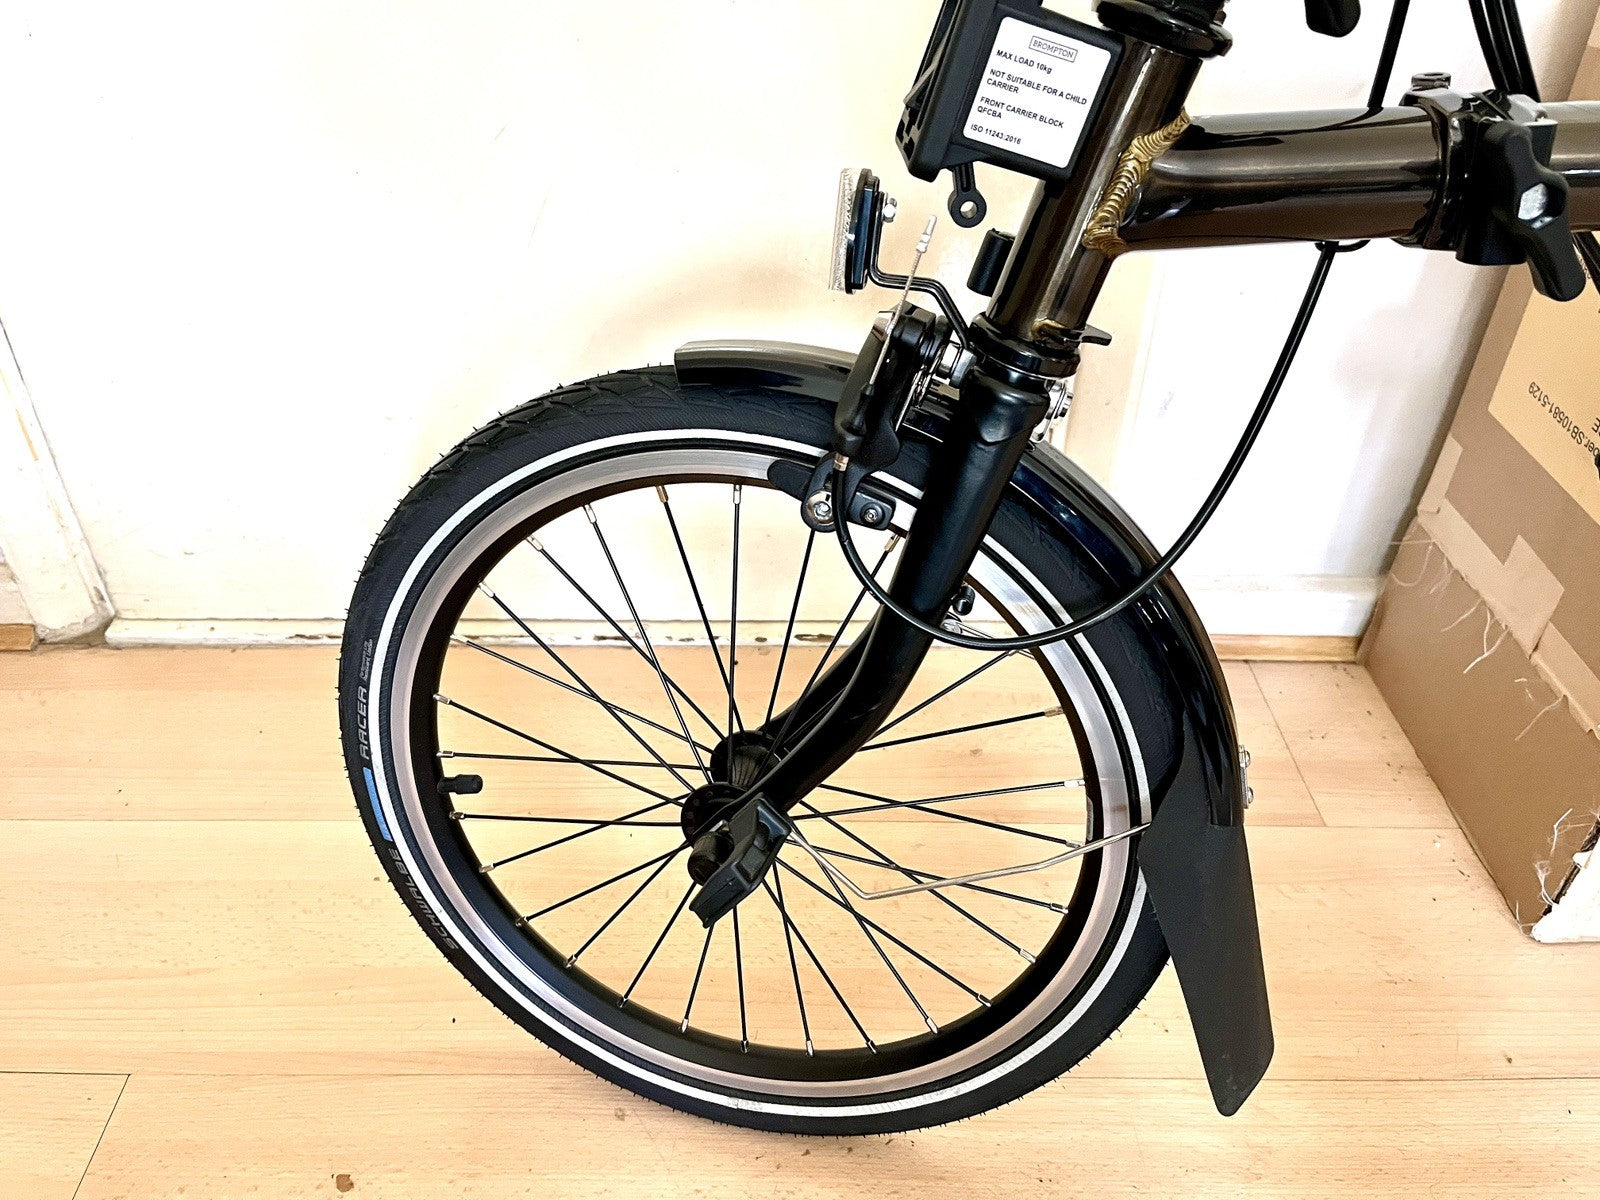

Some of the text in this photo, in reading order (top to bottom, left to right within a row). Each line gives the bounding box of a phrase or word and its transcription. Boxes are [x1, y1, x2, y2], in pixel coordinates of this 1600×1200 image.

[1032, 39, 1075, 58] BROMPTON
[996, 49, 1053, 75] MAX LOAD 10kg
[986, 78, 1020, 94] CARRIER
[989, 68, 1006, 79] NOT
[1006, 73, 1042, 91] SUITABLE
[1042, 85, 1058, 96] FOR
[1065, 92, 1088, 105] CHILD
[977, 105, 1002, 119] QFCBA
[980, 96, 1065, 129] FRONT CARRIER BLOCK
[970, 123, 1022, 145] ISO 11243:2016
[357, 685, 370, 760] RACER
[388, 847, 460, 950] SCHWALBE
